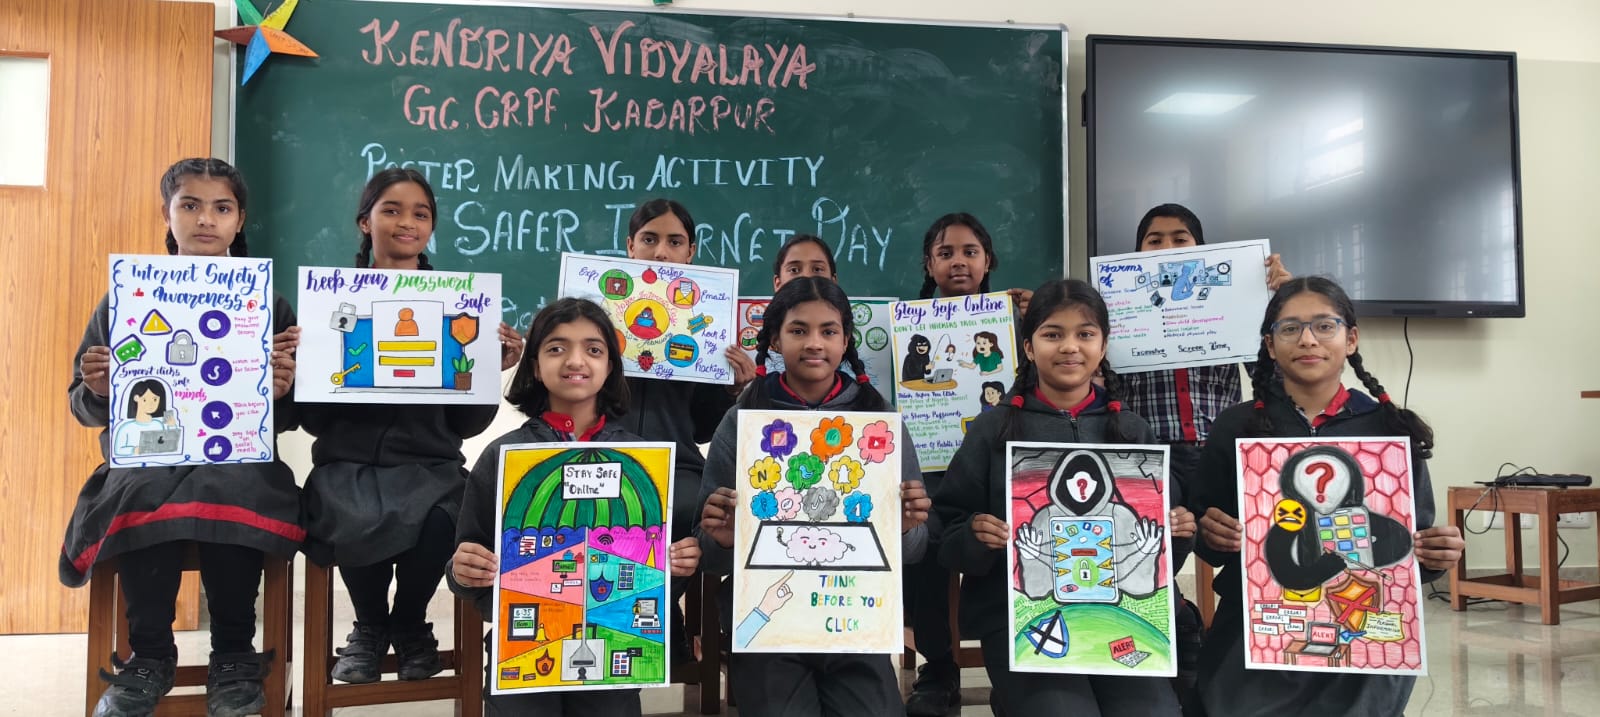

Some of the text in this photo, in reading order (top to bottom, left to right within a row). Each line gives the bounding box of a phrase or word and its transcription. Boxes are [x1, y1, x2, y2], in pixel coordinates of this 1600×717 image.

[360, 18, 816, 90] KENDRIYA VIDYALAYA
[583, 88, 777, 136] KADARPUR
[493, 153, 635, 194] MAKING
[646, 154, 824, 192] ACTIVITY
[453, 200, 584, 256] SAFER
[812, 196, 893, 271] DAY
[131, 263, 260, 296] Internet Safety
[349, 272, 389, 294] your
[392, 272, 475, 295] password
[153, 286, 246, 312] Awareness
[965, 294, 1004, 314] Online
[818, 574, 856, 588] THINK
[810, 592, 883, 608] BEFORE YOU
[825, 616, 859, 632] CLICK
[1312, 631, 1334, 640] ALERT
[1112, 640, 1135, 654] ALERT
